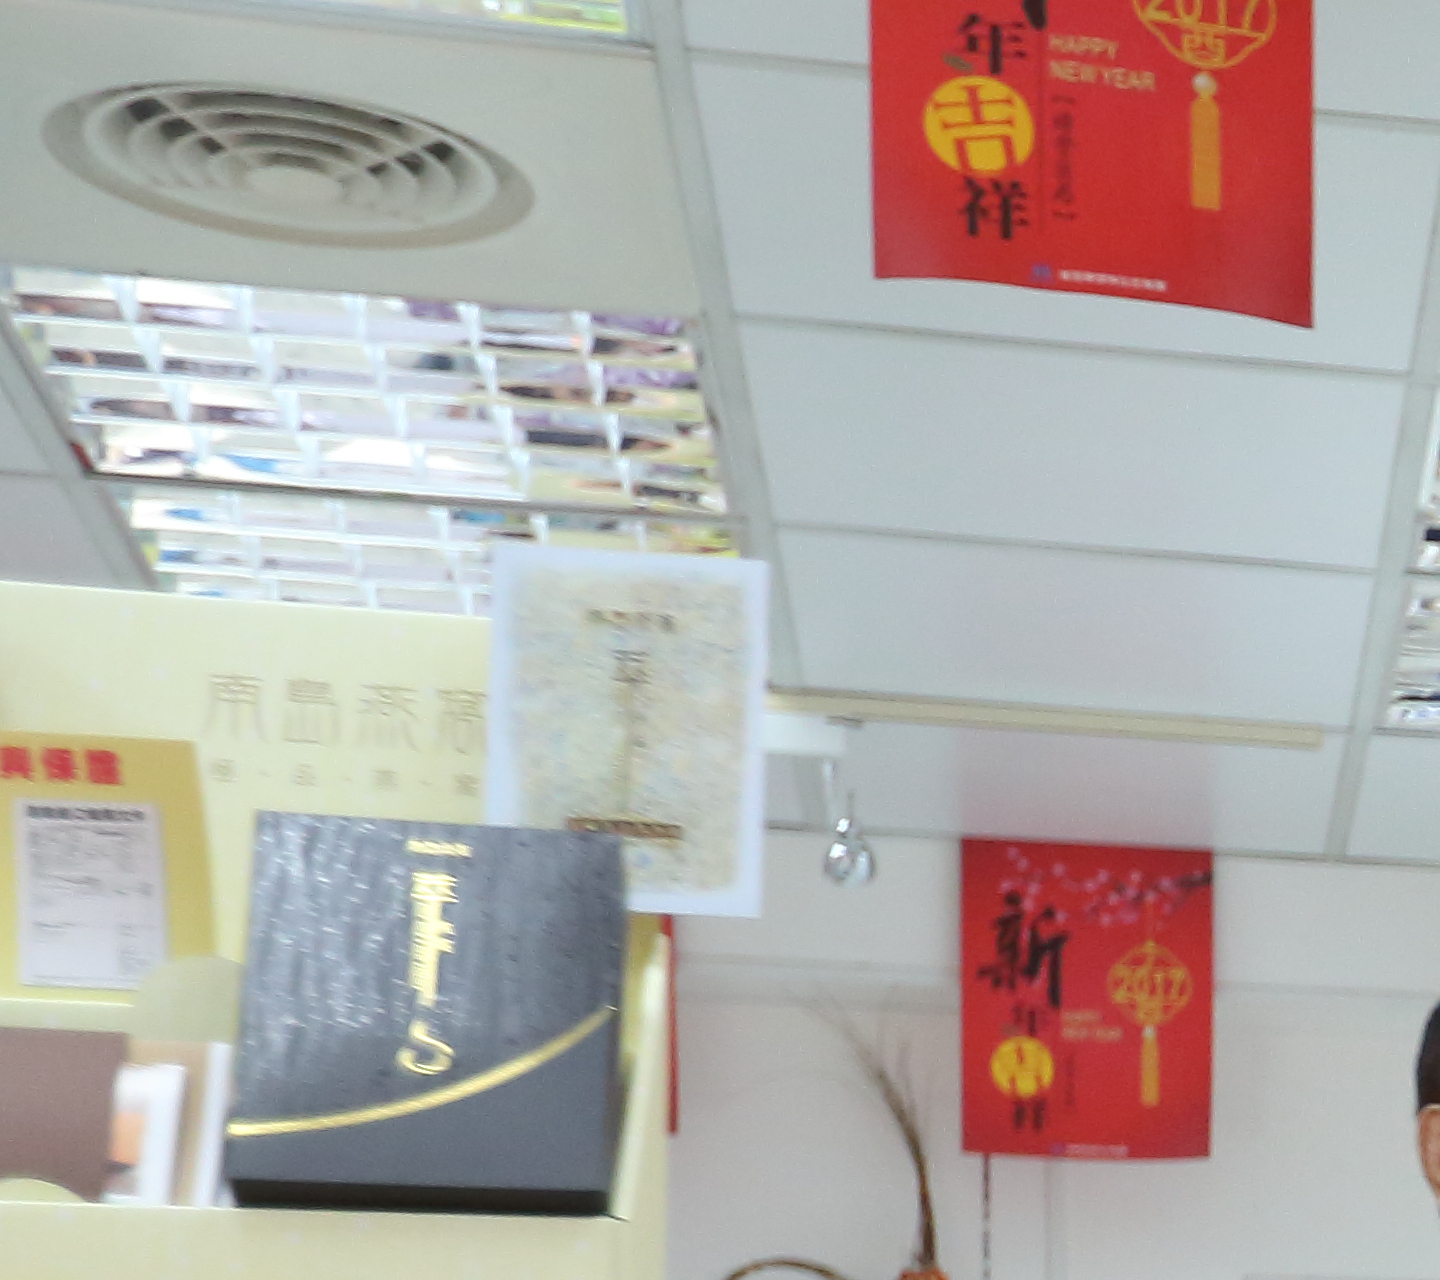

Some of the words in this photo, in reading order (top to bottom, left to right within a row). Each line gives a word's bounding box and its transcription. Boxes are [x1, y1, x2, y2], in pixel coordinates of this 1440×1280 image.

[1048, 35, 1119, 59] HAPPY
[1050, 61, 1096, 85] NEW
[1103, 66, 1155, 91] YEAR
